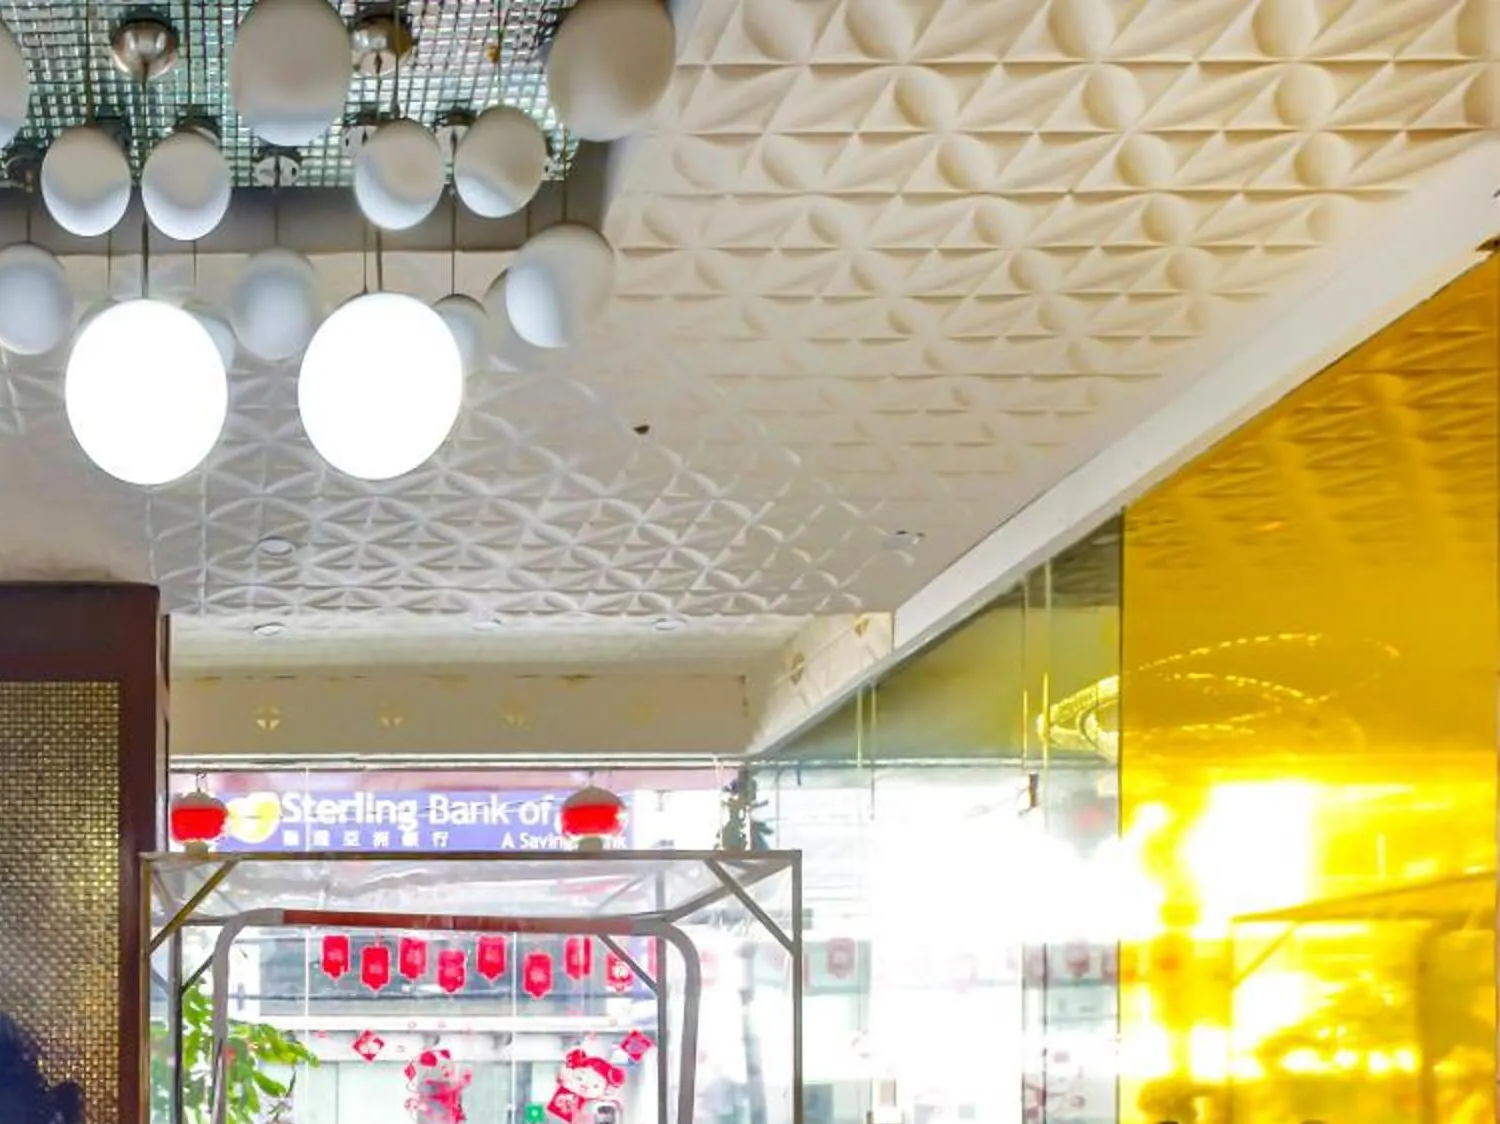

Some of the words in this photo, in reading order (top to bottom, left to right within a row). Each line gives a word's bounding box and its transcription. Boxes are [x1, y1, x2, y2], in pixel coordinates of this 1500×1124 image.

[281, 792, 418, 830] Sterling
[429, 793, 509, 825] Bank
[519, 794, 556, 825] of
[501, 832, 516, 849] A
